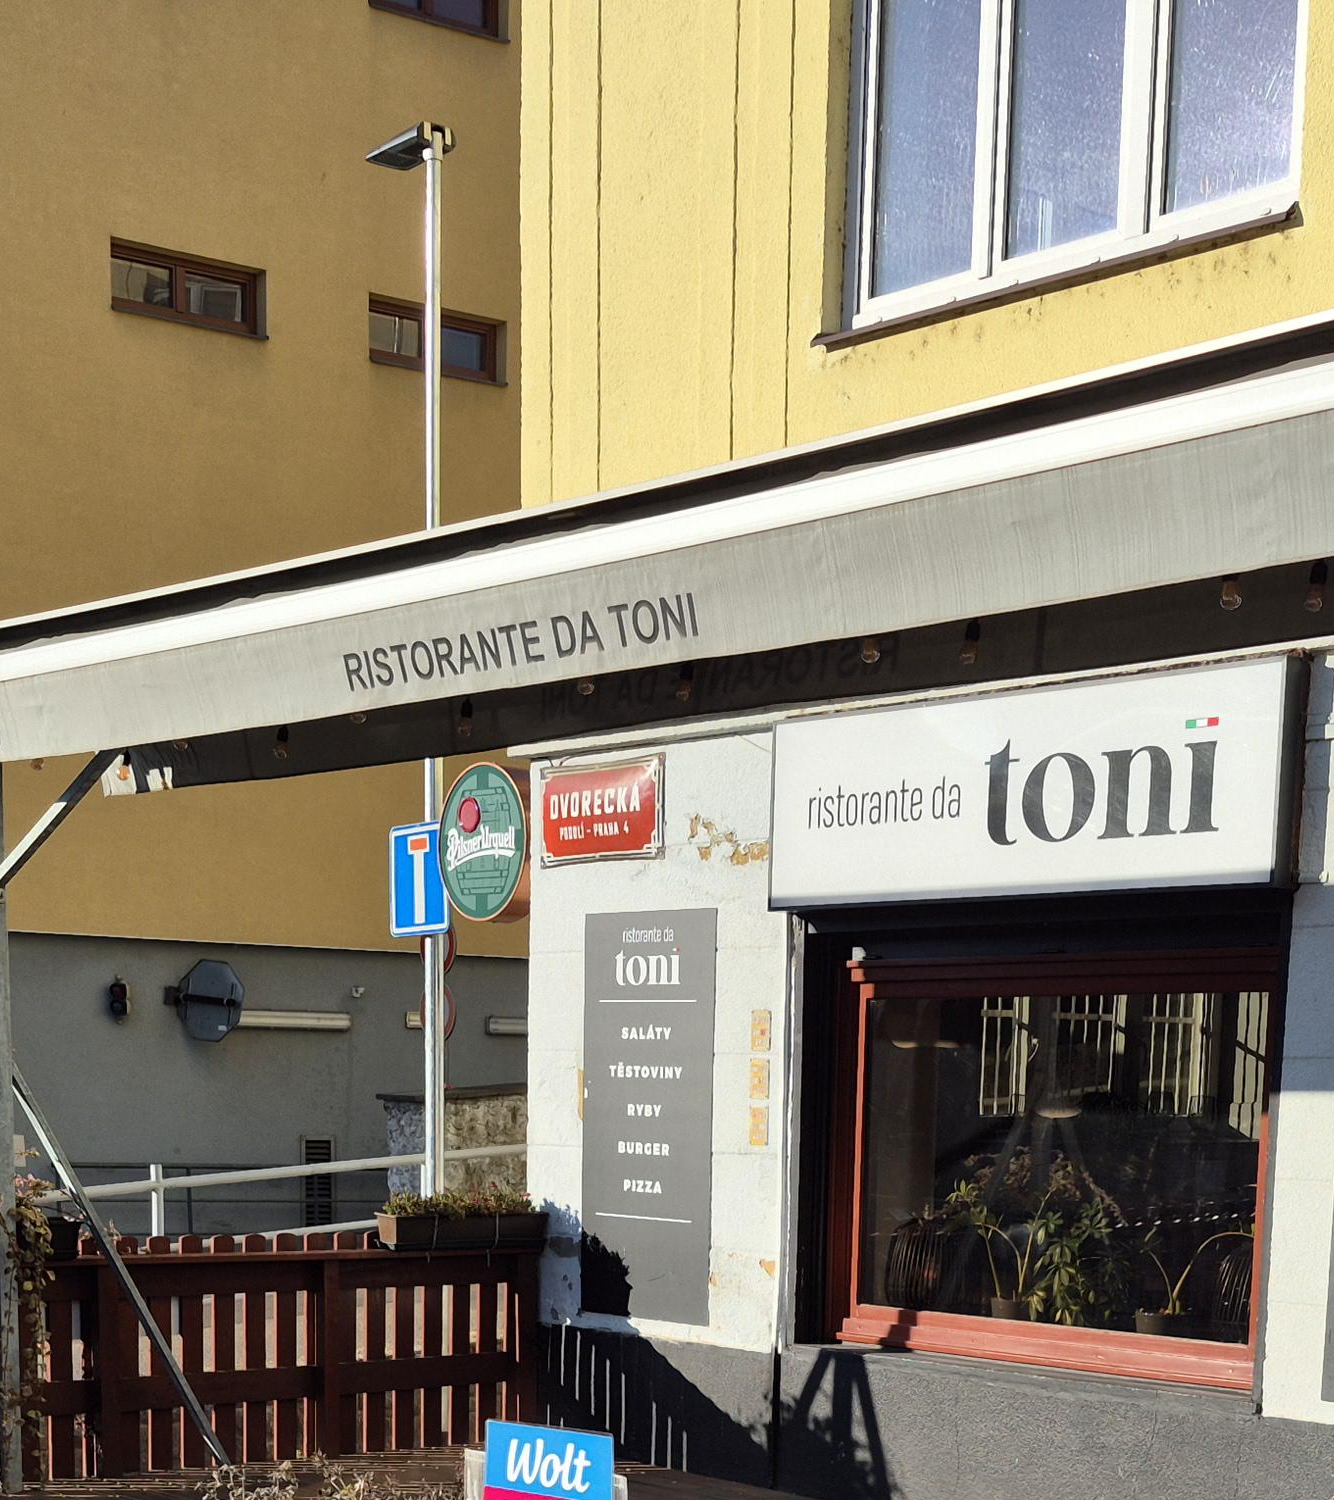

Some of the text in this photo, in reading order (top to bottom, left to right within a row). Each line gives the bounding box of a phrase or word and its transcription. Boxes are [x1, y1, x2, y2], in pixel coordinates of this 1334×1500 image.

[342, 592, 699, 692] RISTORANTE DA TONI
[807, 716, 1220, 846] ristorante da toni
[550, 780, 641, 820] DVORECKÁ
[479, 823, 516, 859] Urquell
[559, 821, 585, 841] PODOLÍ
[593, 822, 620, 838] PRAHA
[623, 820, 630, 836] 4
[623, 925, 674, 943] ristorante da
[615, 947, 681, 986] toni
[621, 1024, 671, 1040] SALÁTY
[609, 1062, 683, 1080] TĚSTOVINY
[627, 1103, 662, 1117] RYBY
[618, 1141, 670, 1156] BURGER
[623, 1179, 662, 1194] PIZZA
[506, 1437, 592, 1494] Wolt
